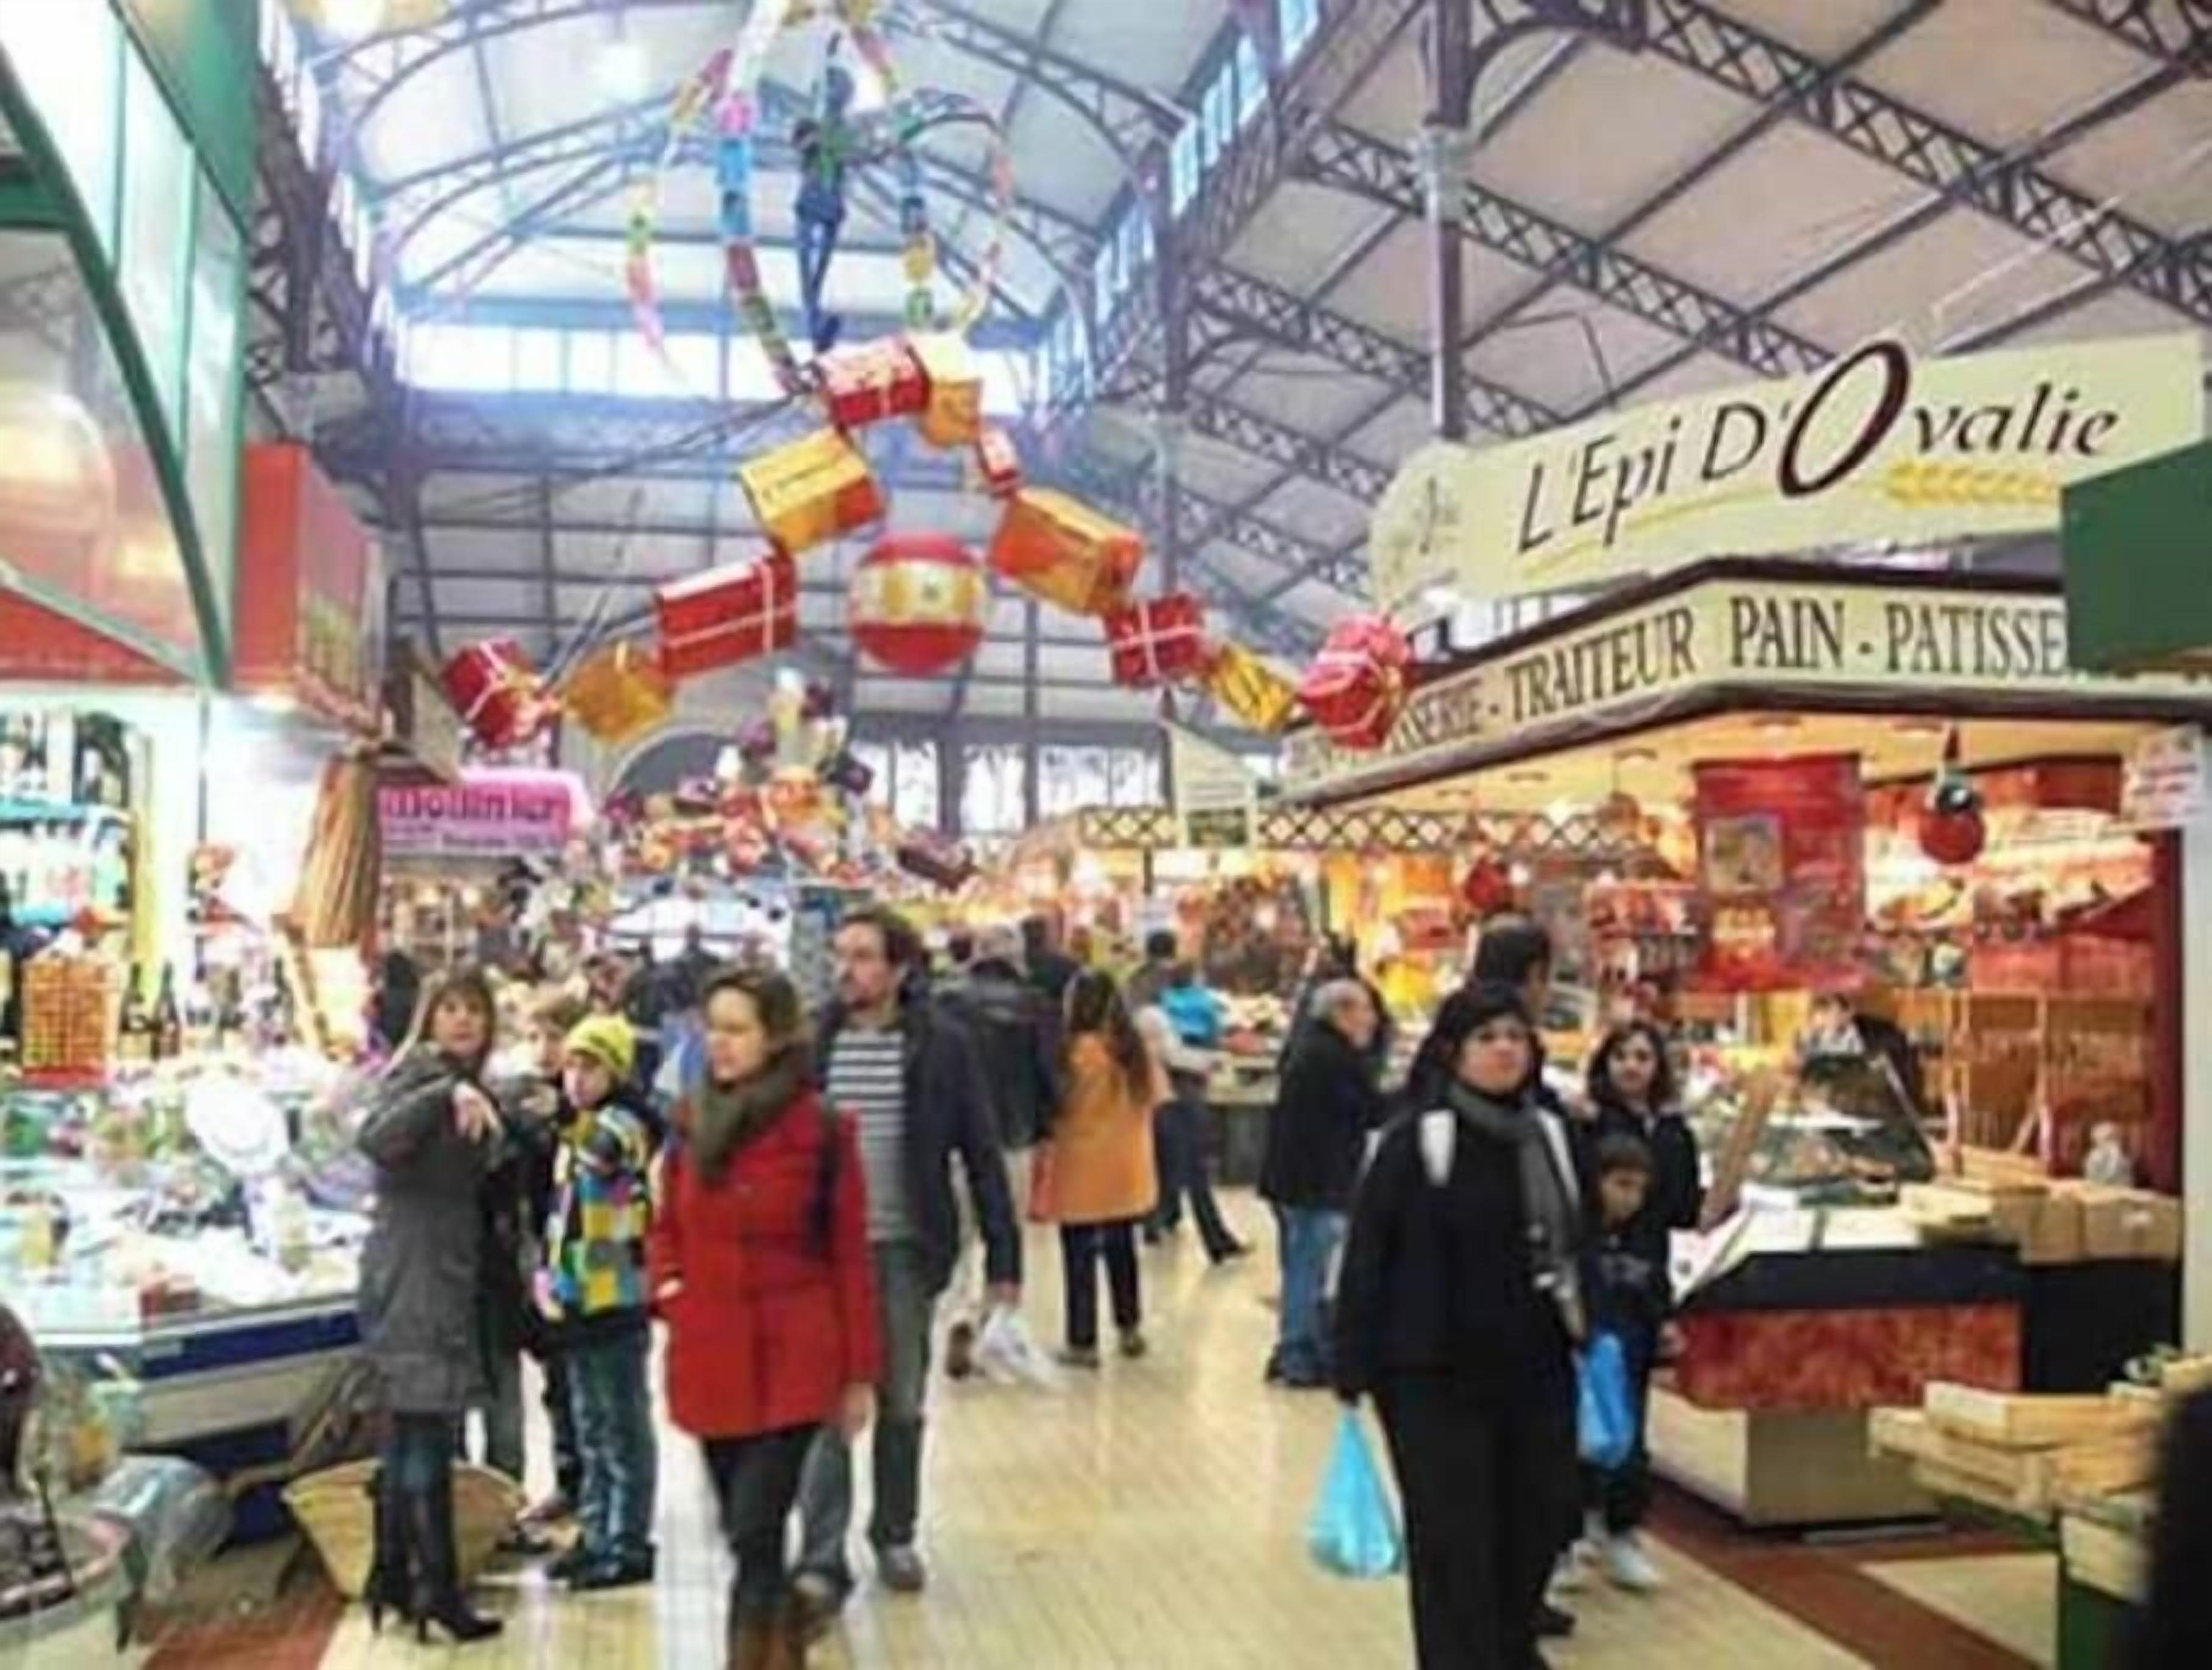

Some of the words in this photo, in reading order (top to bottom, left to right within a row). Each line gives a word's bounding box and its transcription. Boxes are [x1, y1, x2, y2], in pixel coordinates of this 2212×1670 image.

[1517, 415, 1682, 554] L'Epi
[1503, 605, 1697, 723] TRAITEUR
[1729, 595, 1845, 668] PAIN
